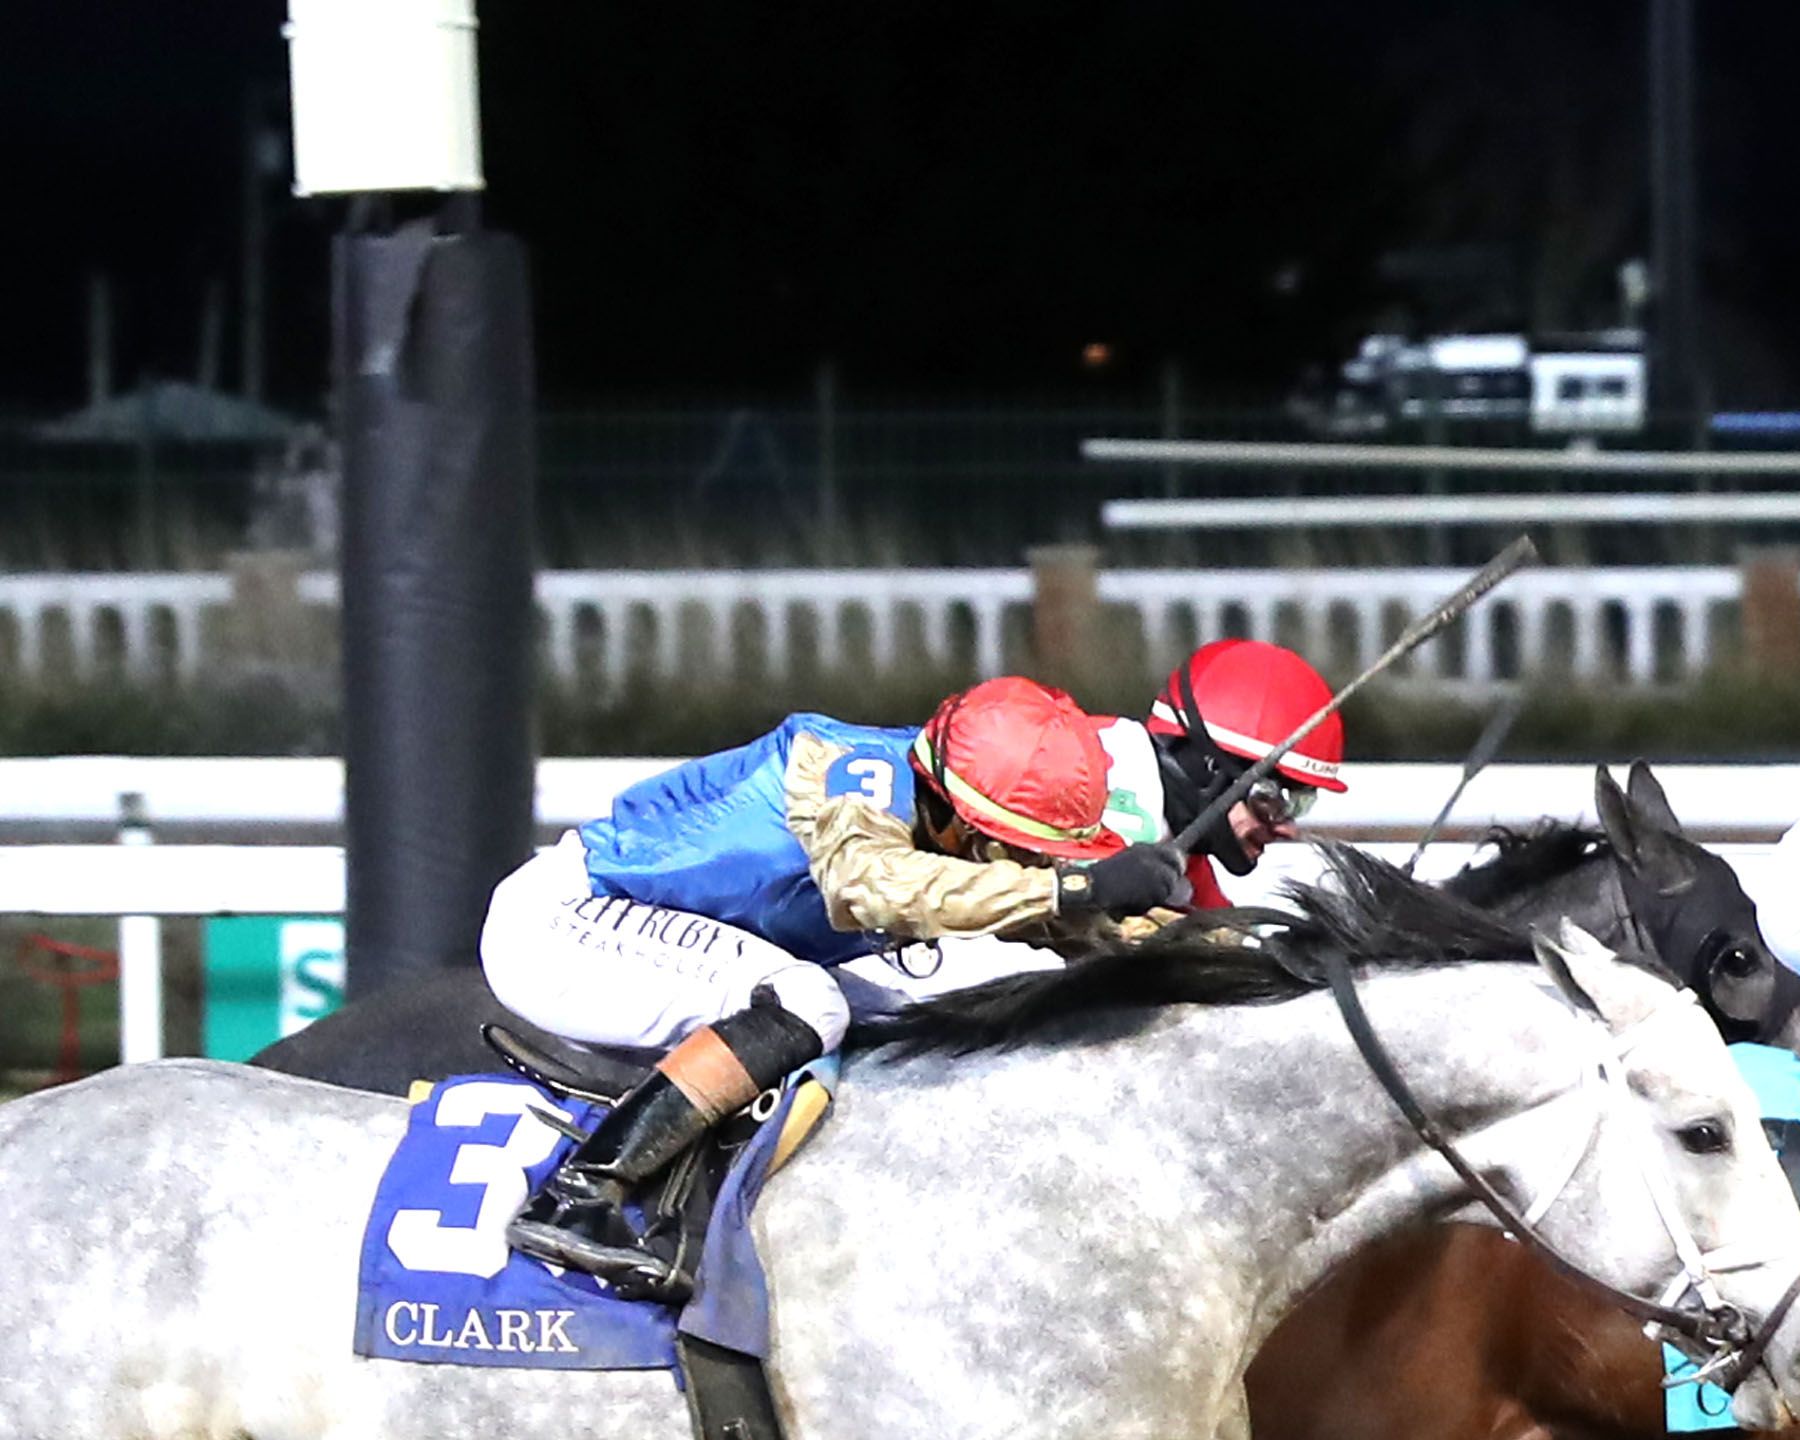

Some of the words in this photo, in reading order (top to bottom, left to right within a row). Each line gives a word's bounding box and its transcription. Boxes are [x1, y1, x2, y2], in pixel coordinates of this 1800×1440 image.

[845, 757, 894, 810] 3
[386, 1081, 573, 1280] 3
[385, 1300, 579, 1354] CLARK
